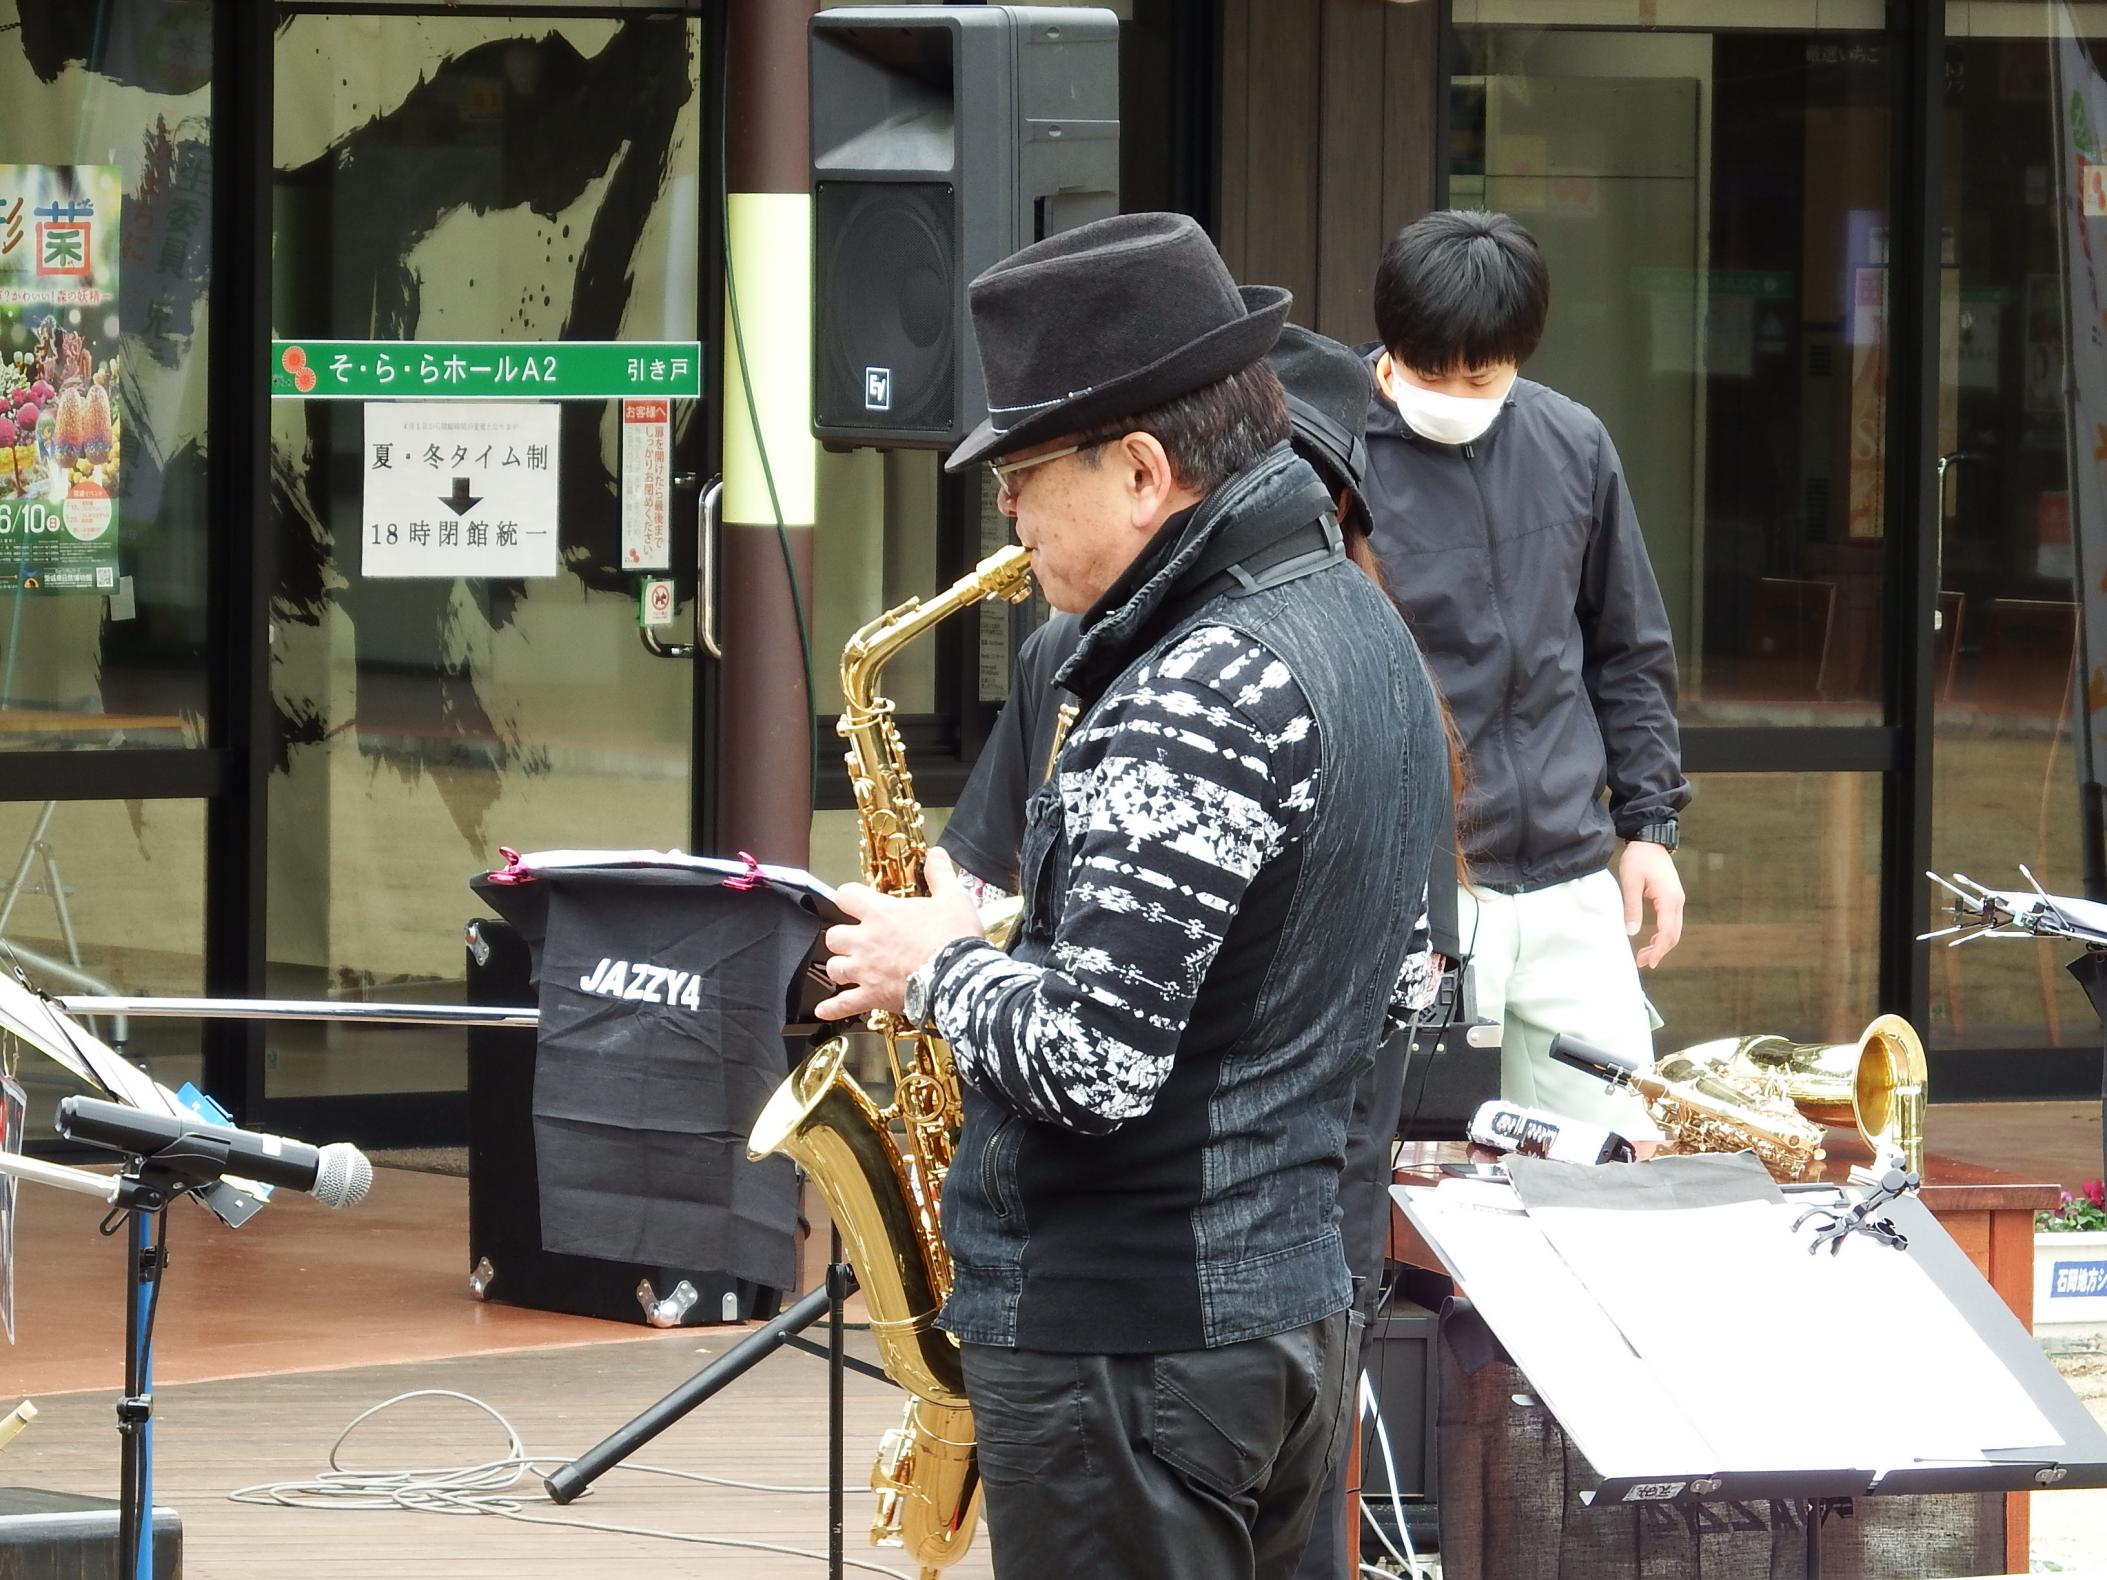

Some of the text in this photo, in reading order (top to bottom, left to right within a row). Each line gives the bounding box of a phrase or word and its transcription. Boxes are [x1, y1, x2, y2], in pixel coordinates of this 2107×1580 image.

[329, 353, 557, 383] そ・ら・らホールA2
[627, 358, 689, 382] 引き戸
[868, 372, 887, 403] EV
[625, 404, 668, 419] お客様へ
[372, 443, 549, 471] 夏・冬タイム制
[654, 426, 665, 549] 扉を開けたら最後まで
[580, 957, 702, 1012] JAZZY4
